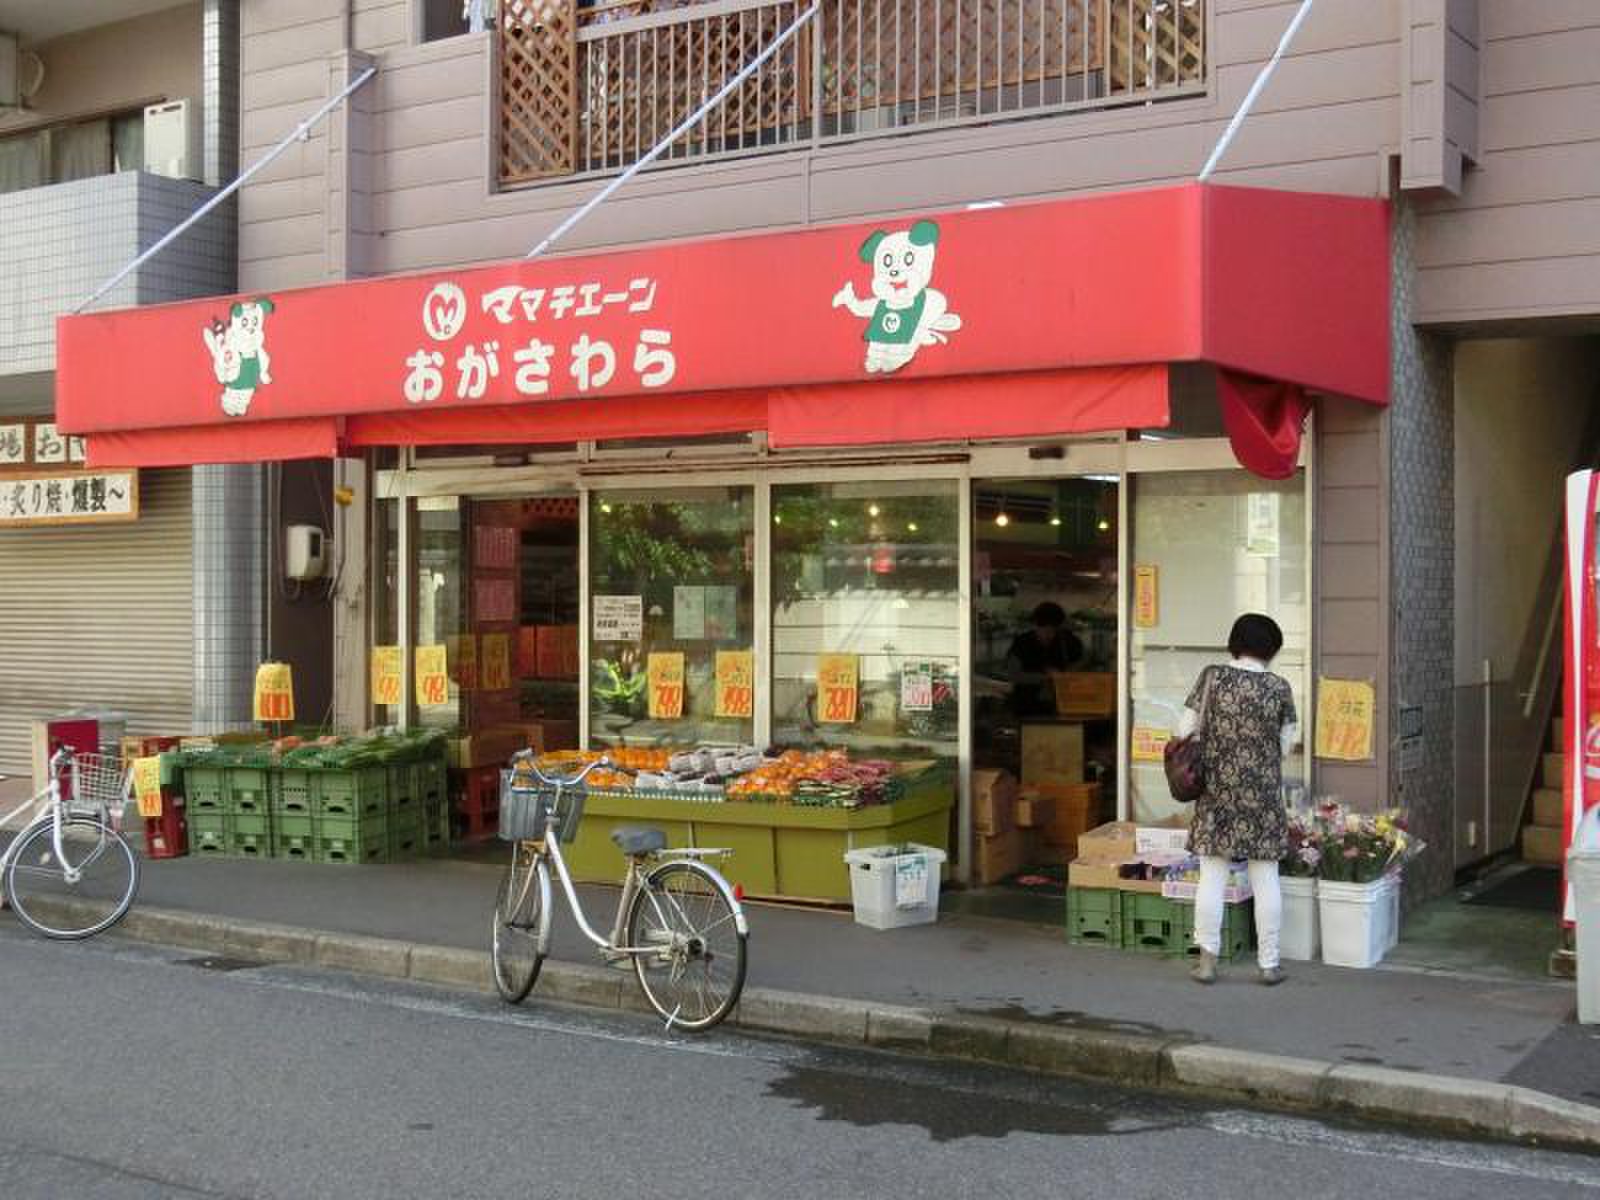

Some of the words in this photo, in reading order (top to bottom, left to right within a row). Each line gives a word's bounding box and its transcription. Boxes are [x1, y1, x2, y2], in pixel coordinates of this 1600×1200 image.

[403, 329, 677, 404] おがさわら
